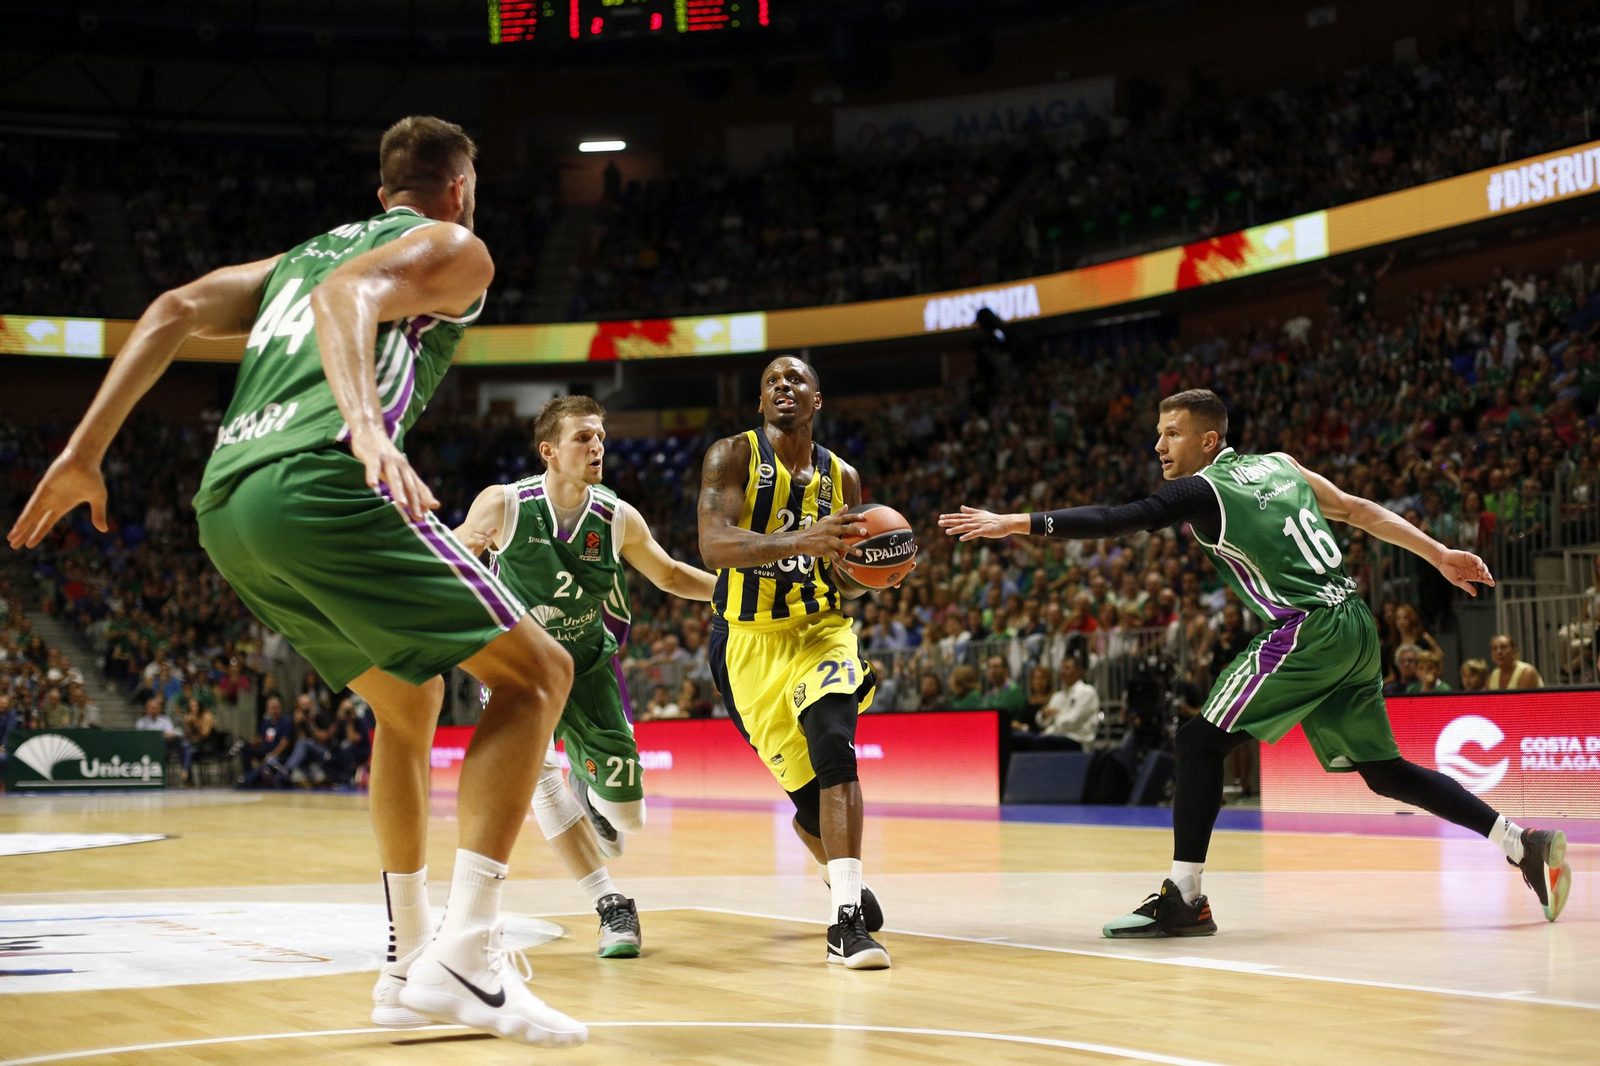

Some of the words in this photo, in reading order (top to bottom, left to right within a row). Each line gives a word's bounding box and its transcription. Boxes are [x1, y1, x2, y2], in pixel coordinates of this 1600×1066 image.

[247, 279, 315, 356] 44
[1283, 508, 1342, 574] 16
[817, 658, 856, 690] 21
[80, 754, 163, 781] Unicaja
[605, 756, 635, 787] 21
